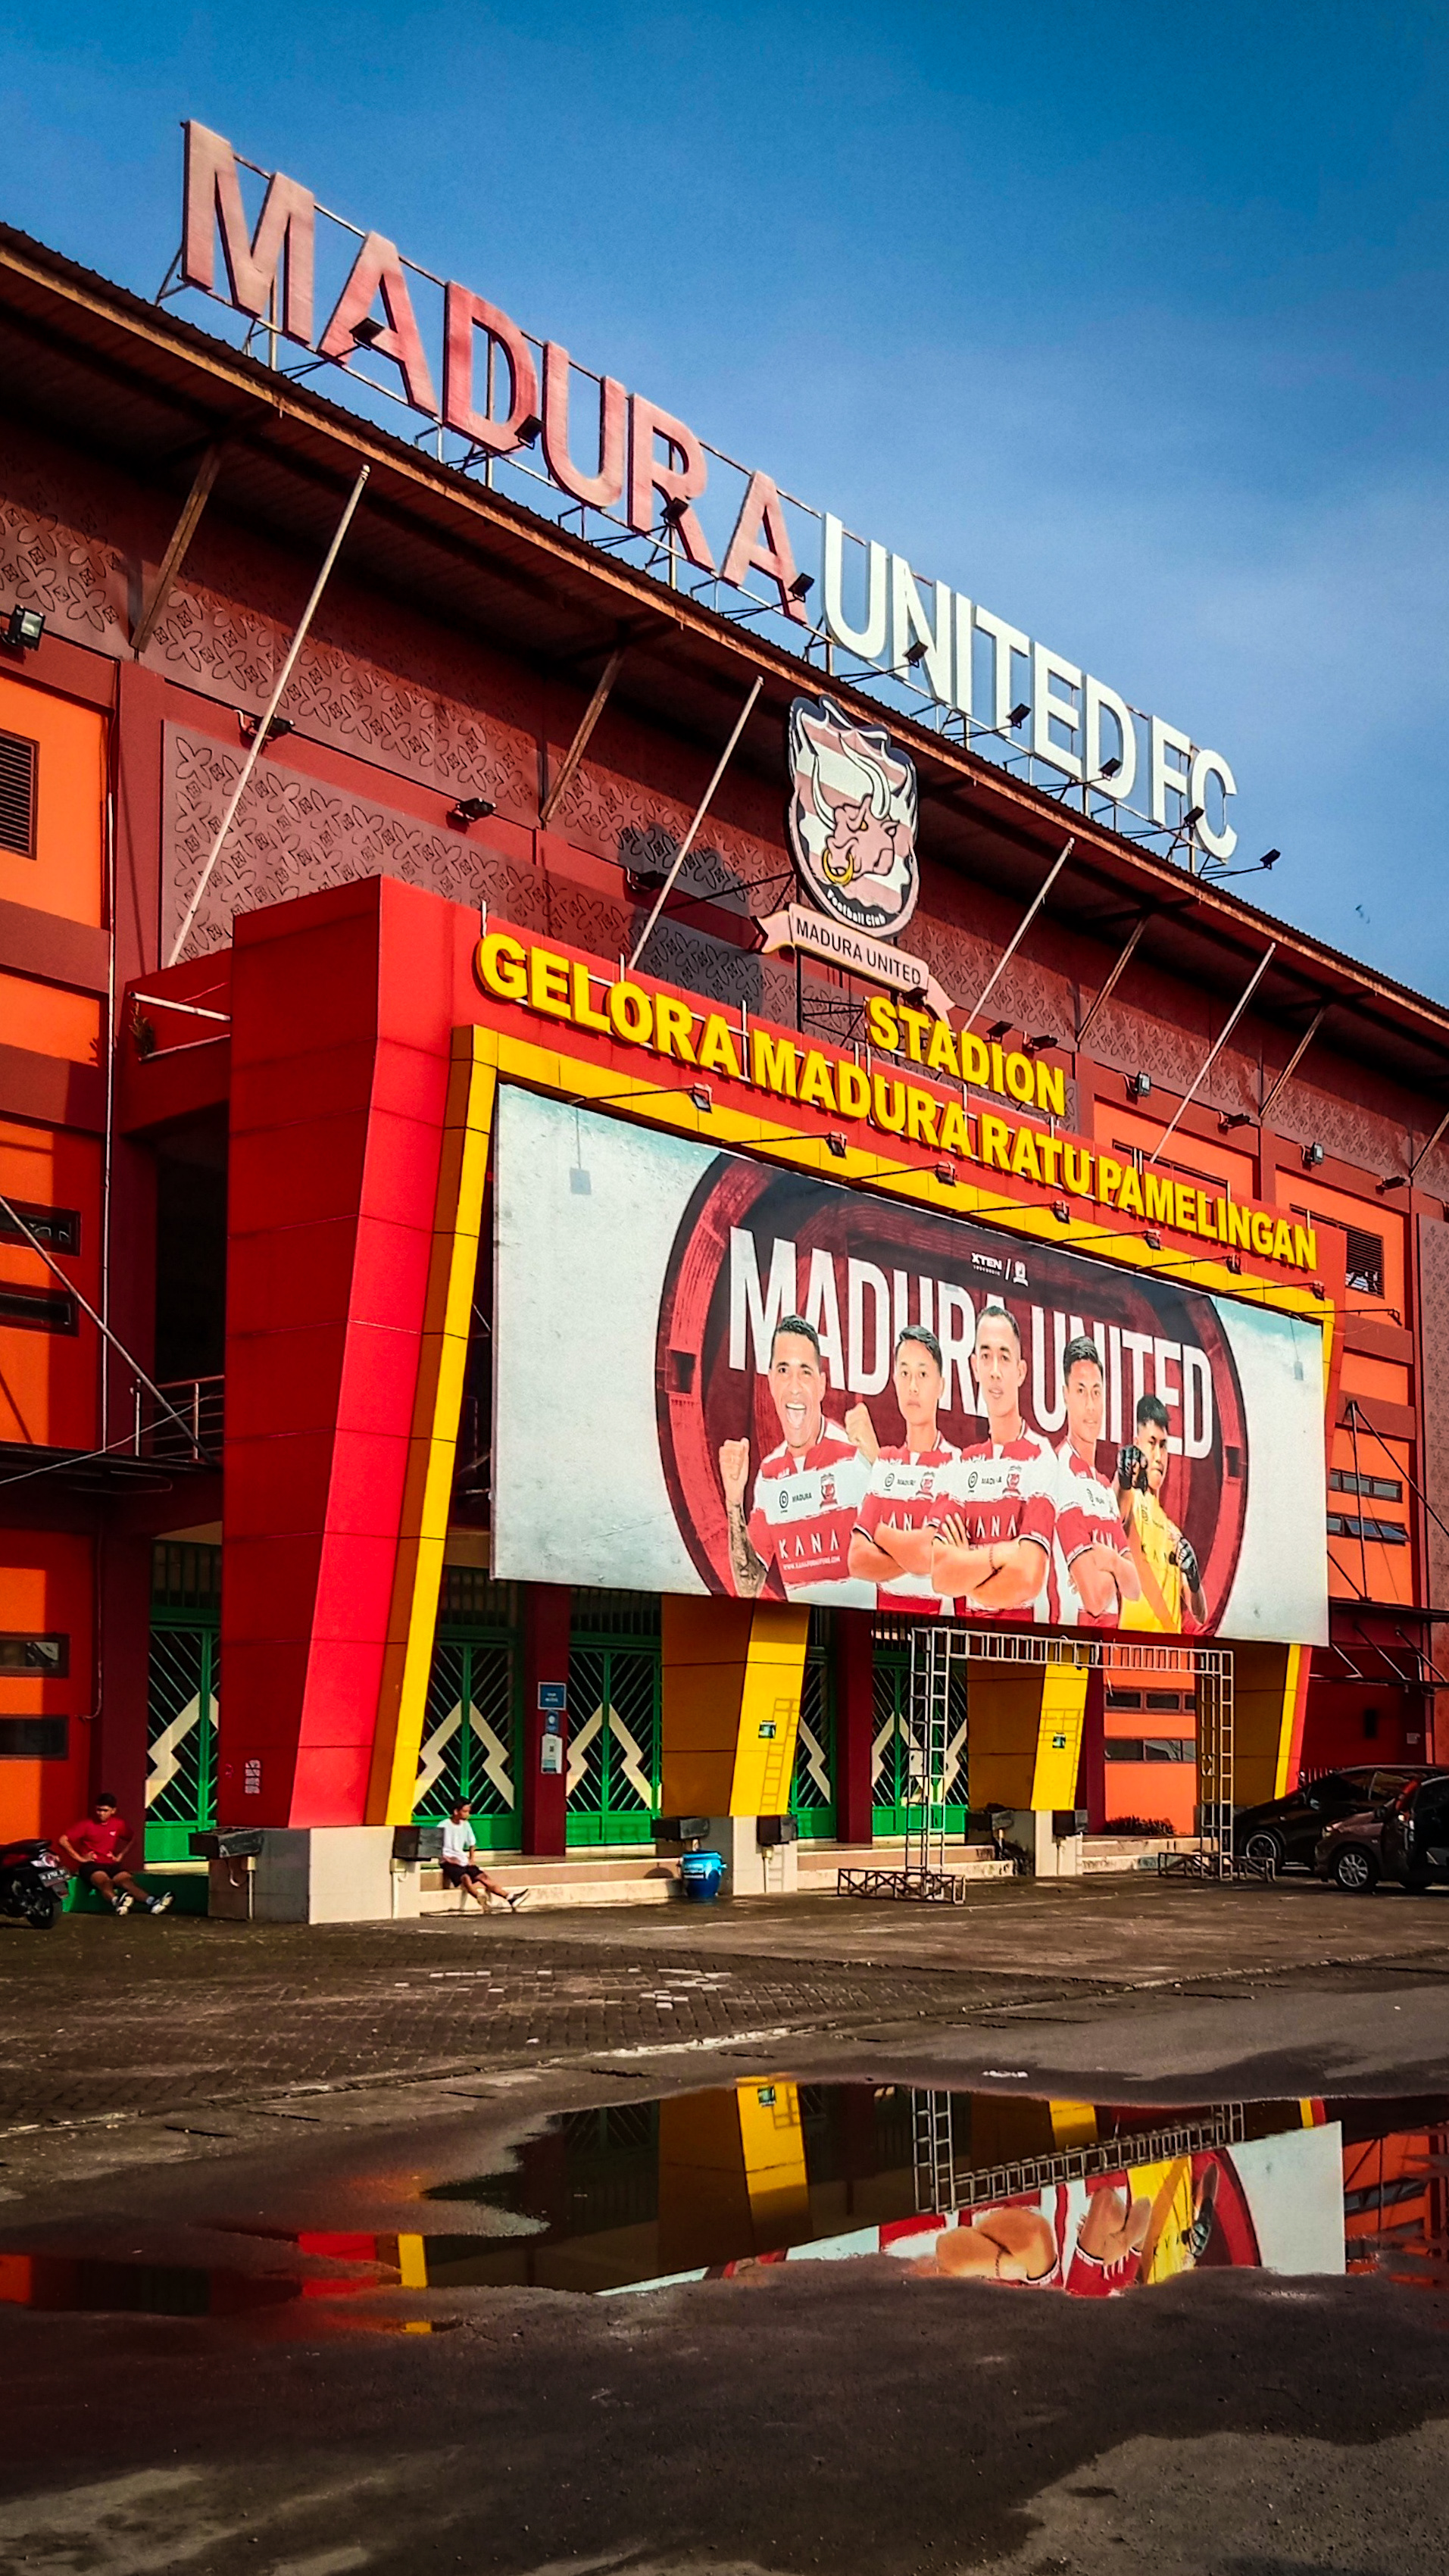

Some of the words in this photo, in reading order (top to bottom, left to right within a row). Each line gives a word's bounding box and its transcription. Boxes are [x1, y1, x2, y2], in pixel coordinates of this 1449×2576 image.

[183, 120, 807, 626] MADURA
[820, 512, 1138, 801] UNITED
[1148, 714, 1238, 864] FC
[796, 917, 863, 963] MADURA
[867, 948, 921, 985] UNITED
[827, 888, 864, 925] Football
[866, 913, 886, 927] Club
[477, 932, 741, 1079] GELORA
[750, 1029, 972, 1158] MADURA
[978, 1113, 1091, 1195] RATU
[1098, 1155, 1316, 1271] PAMELINGAN
[865, 996, 1066, 1116] STADION
[971, 1252, 1002, 1270] XTEN
[729, 1226, 1005, 1419] MADUR
[779, 1528, 839, 1560] KANA
